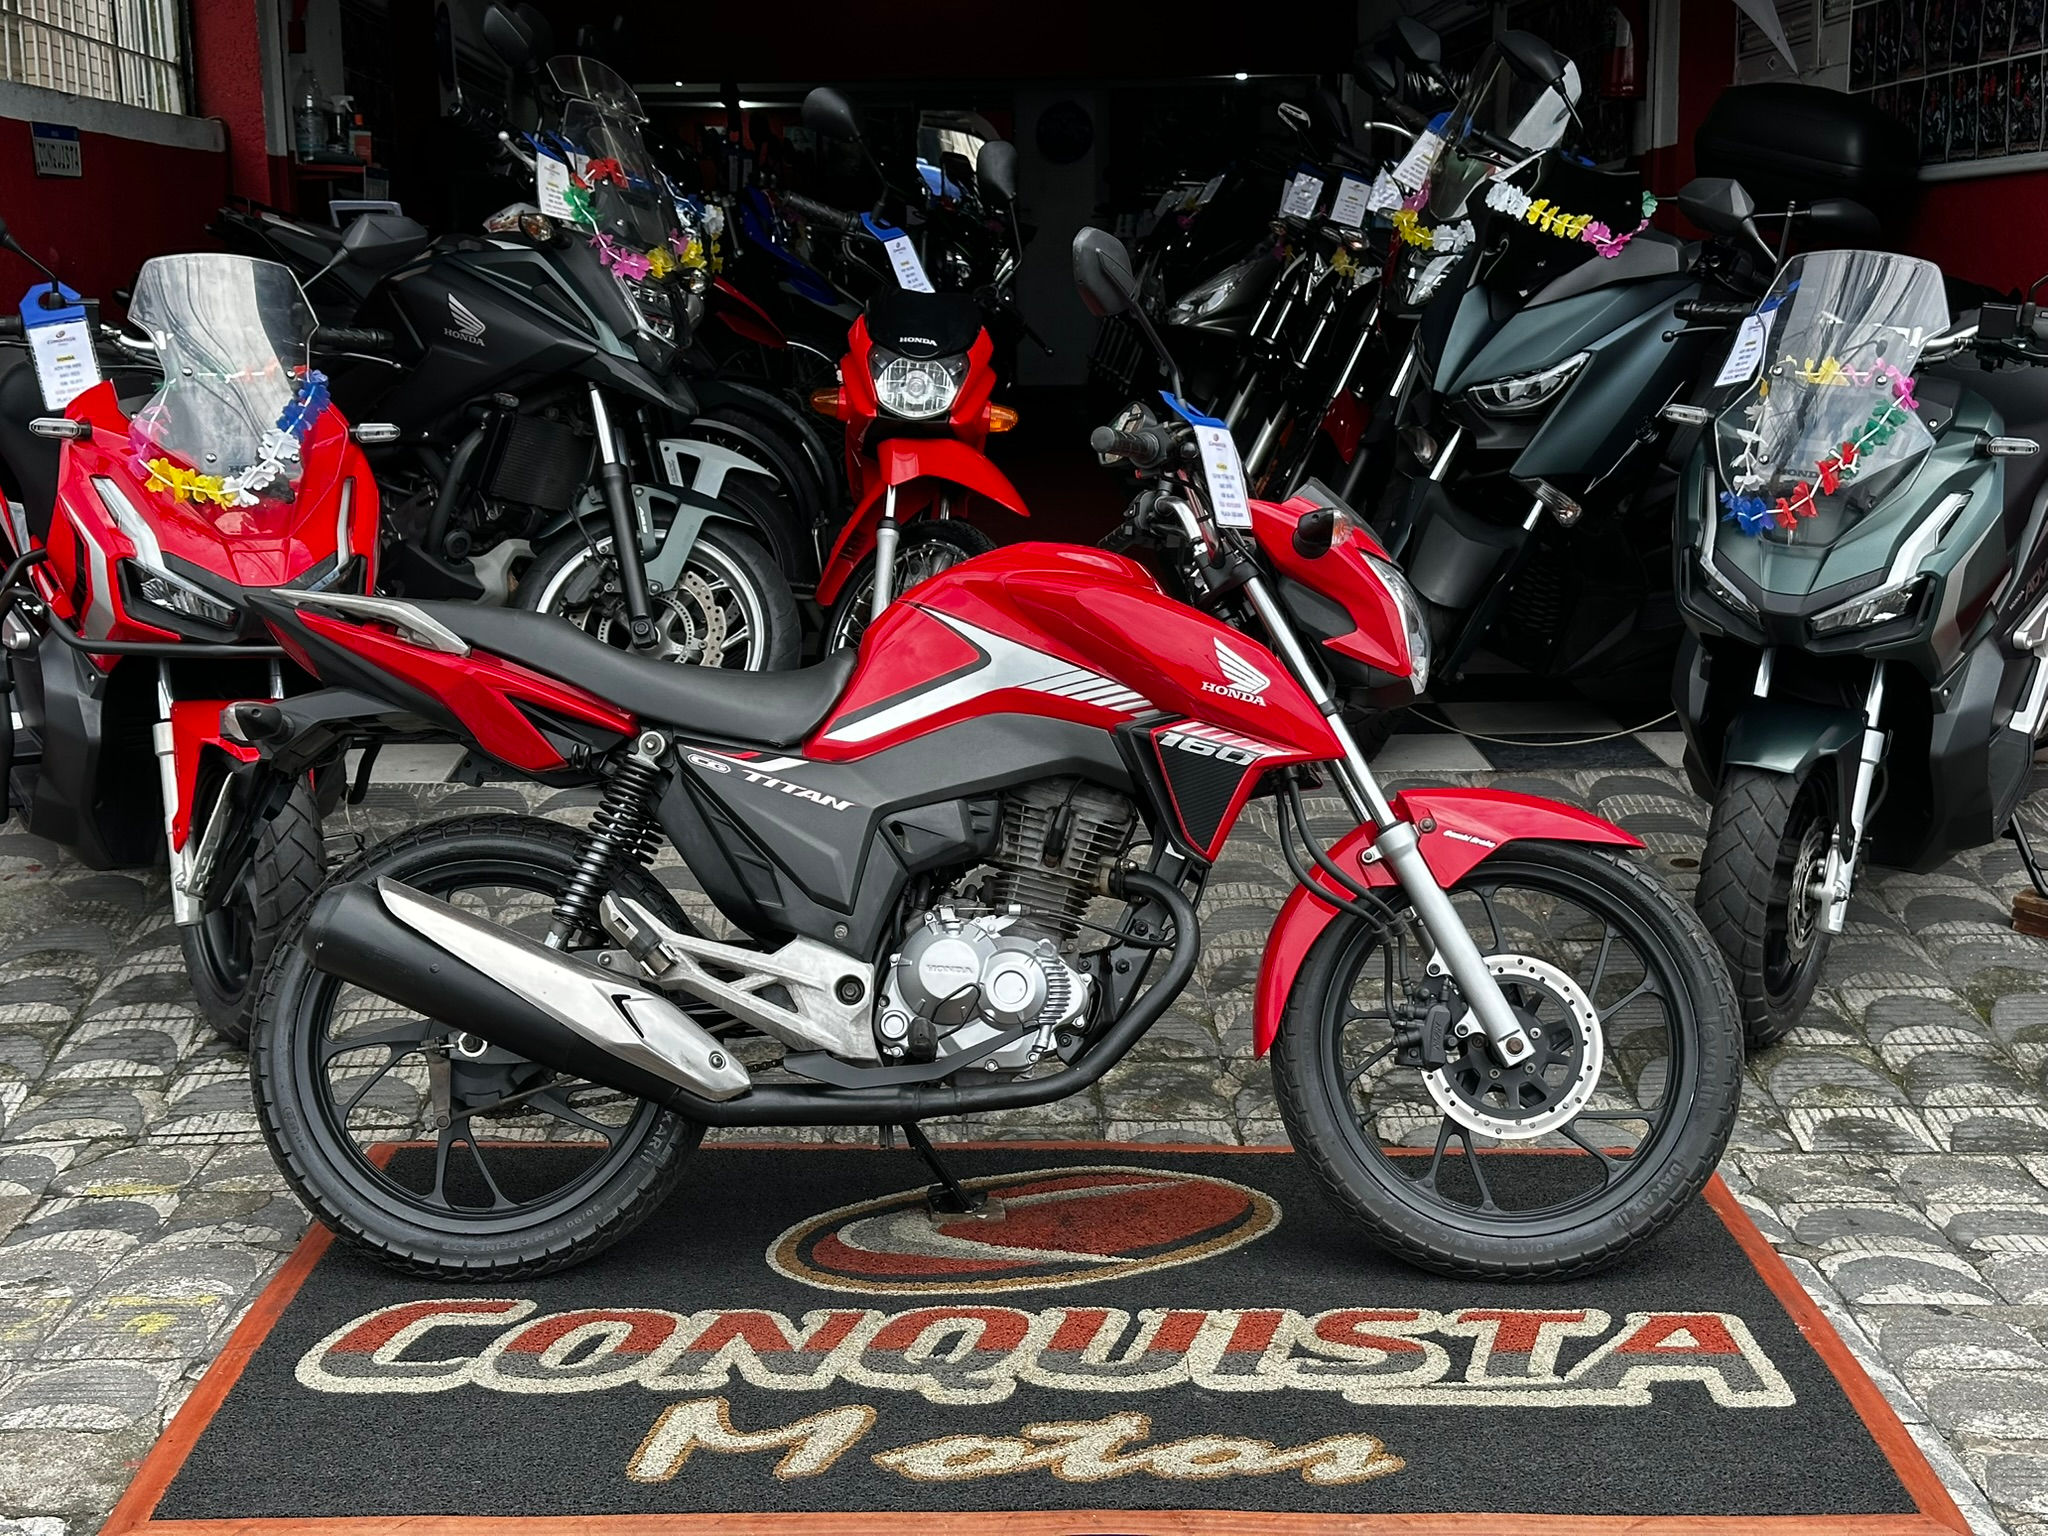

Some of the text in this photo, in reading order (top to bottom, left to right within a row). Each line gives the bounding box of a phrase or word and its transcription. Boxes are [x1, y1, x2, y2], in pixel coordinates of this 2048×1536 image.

[443, 327, 486, 347] HONDA
[899, 336, 938, 347] HONDA
[1200, 681, 1267, 707] HONDA
[1159, 731, 1262, 766] 160
[687, 752, 858, 812] CG TITAN
[926, 964, 974, 974] HONDA
[1629, 1161, 1685, 1217] DAKAR
[294, 1298, 1797, 1410] CONQUISTA
[625, 1396, 1407, 1487] Motos
